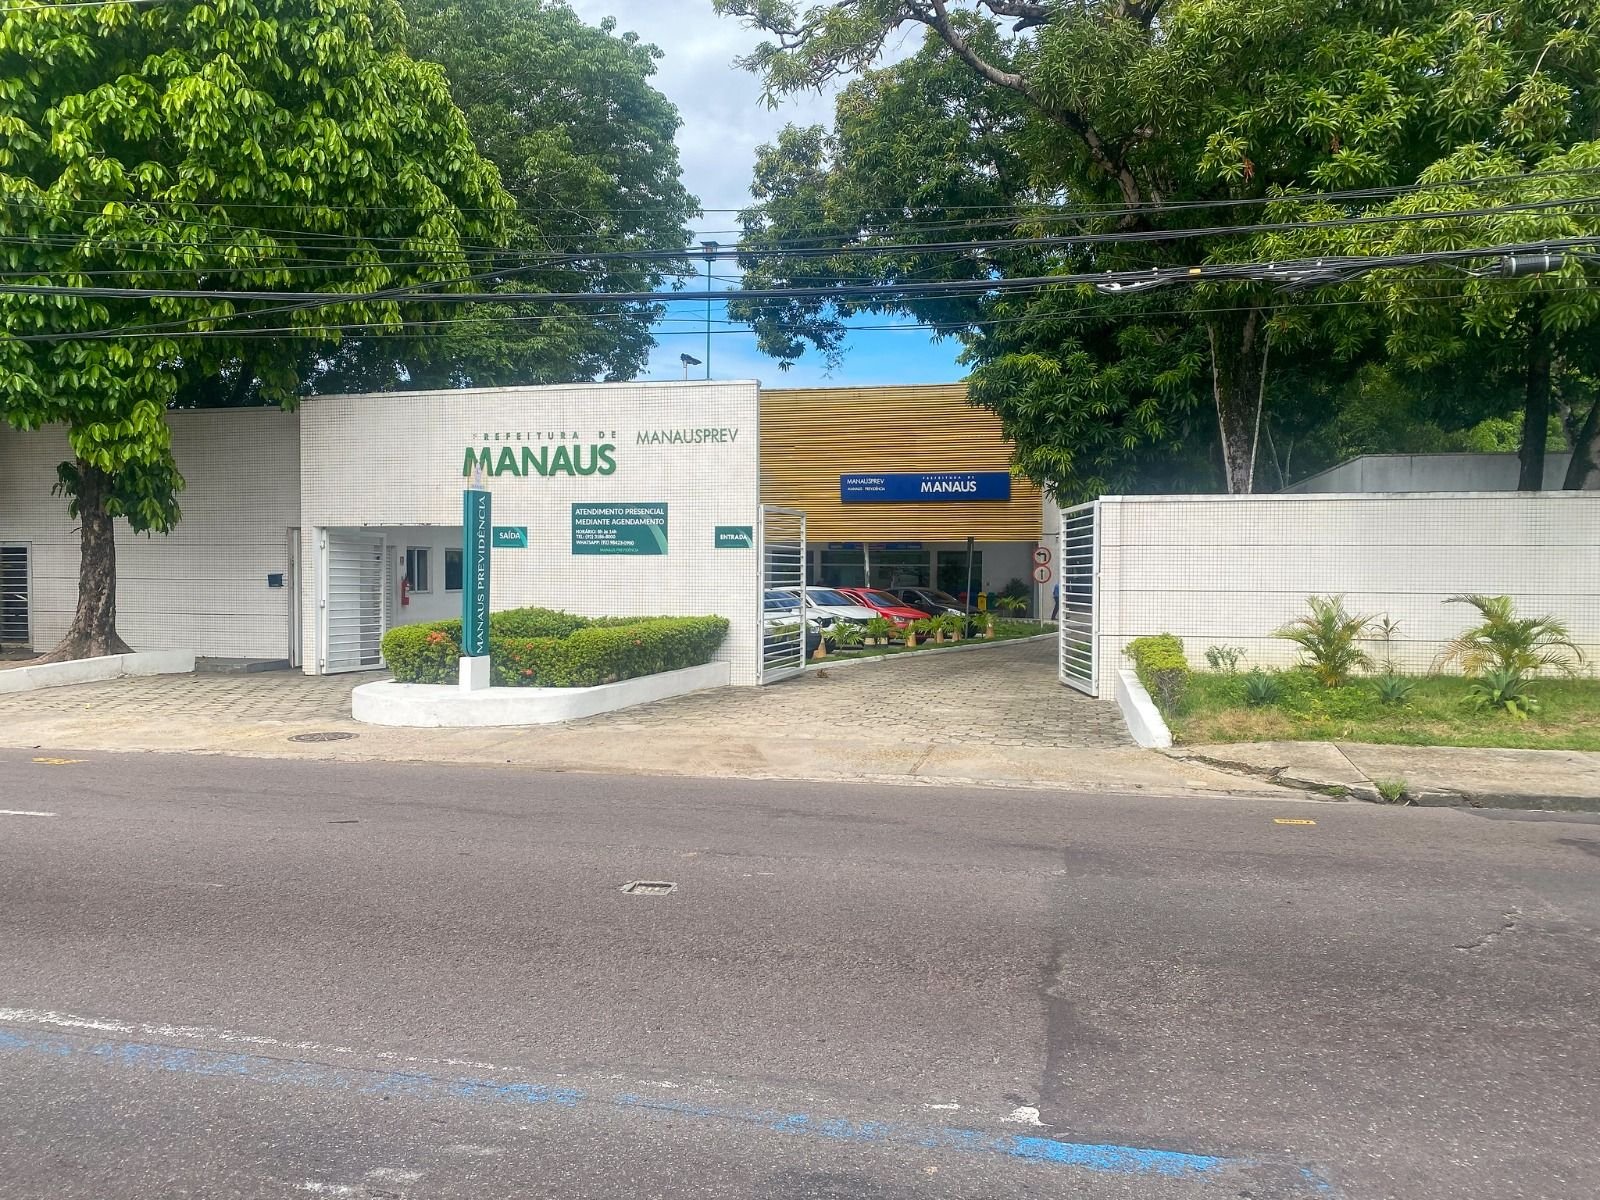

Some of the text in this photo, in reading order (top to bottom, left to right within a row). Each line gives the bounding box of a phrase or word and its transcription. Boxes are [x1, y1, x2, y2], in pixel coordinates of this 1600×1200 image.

[473, 430, 617, 440] REFEITURA DE
[636, 428, 738, 446] MANAUSPREV
[463, 443, 617, 477] MANAUS
[920, 481, 977, 493] MANAUS
[575, 518, 610, 526] MEDIANTE
[477, 495, 486, 590] PREVIDÊNCIA
[499, 530, 521, 540] SAÍDA
[476, 593, 485, 654] MANAUS
